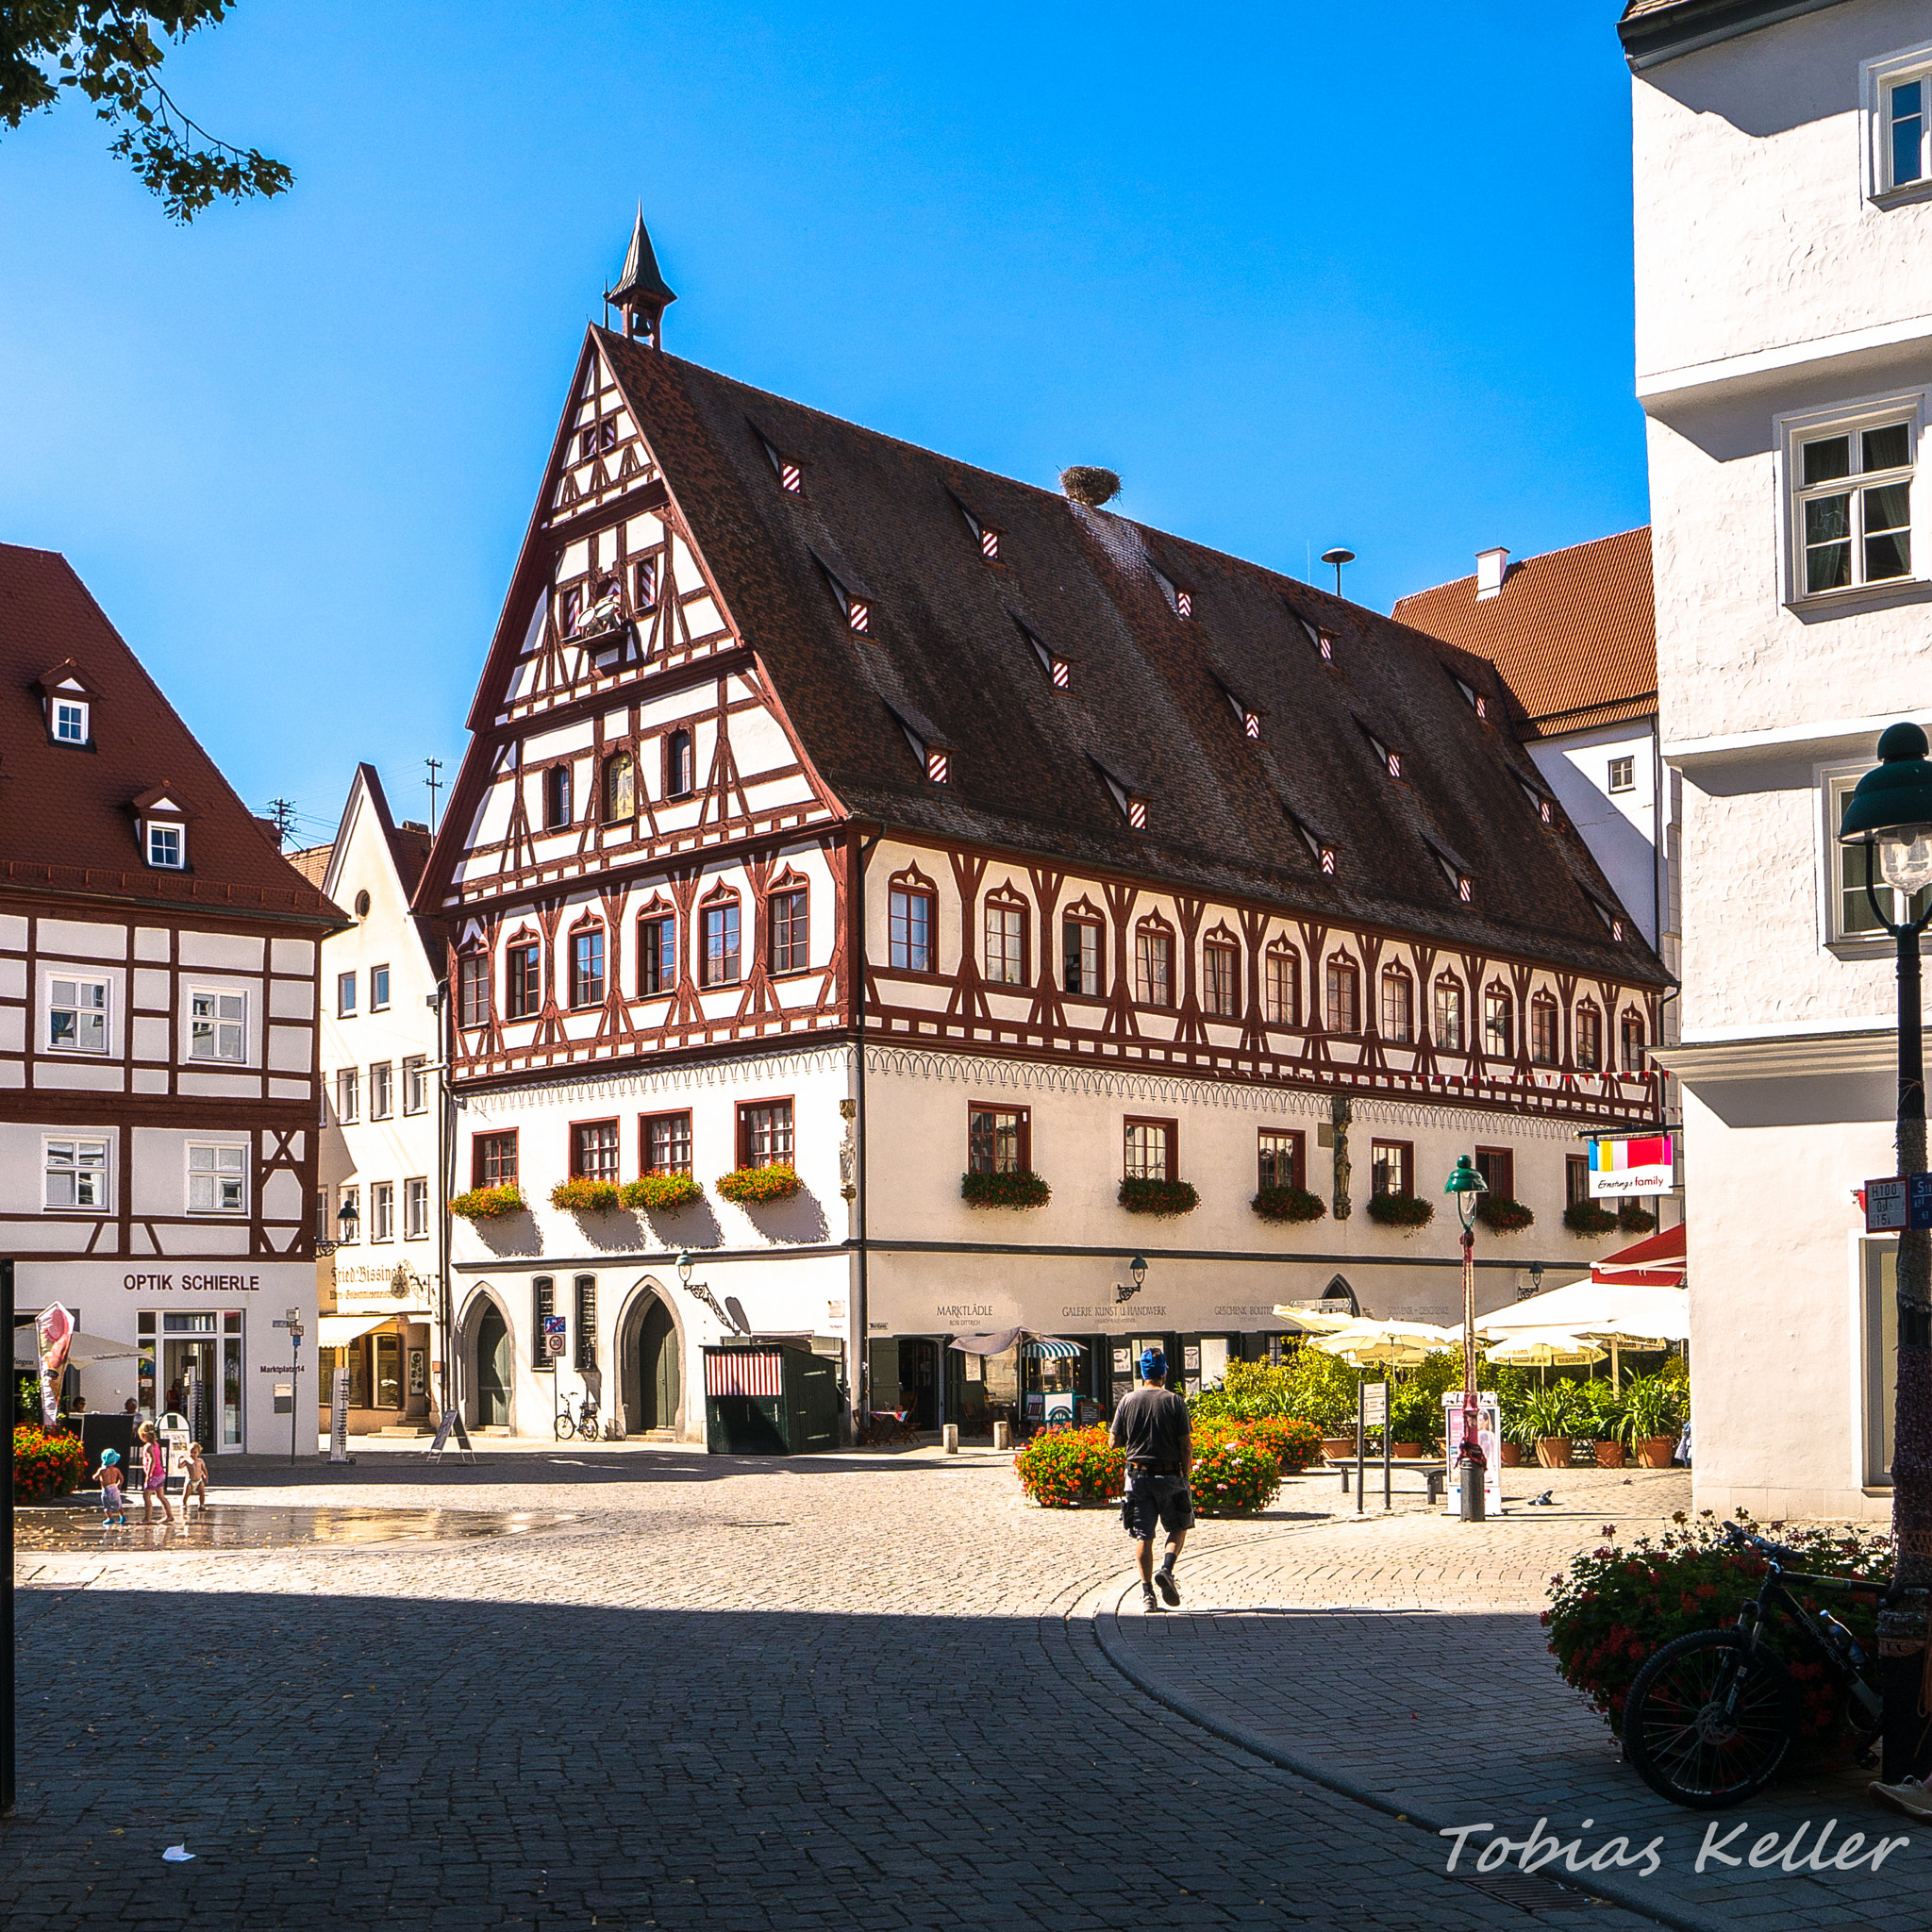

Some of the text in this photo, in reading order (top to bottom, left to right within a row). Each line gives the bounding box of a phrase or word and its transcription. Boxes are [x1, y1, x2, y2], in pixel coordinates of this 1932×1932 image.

[1635, 1175, 1664, 1188] family
[124, 1274, 260, 1291] OPTIK SCHIERLE
[936, 1303, 993, 1319] MARKTLÄDLE
[1061, 1307, 1092, 1317] GALERIE
[1094, 1307, 1118, 1317] KUNST
[1127, 1306, 1167, 1316] HANDWERK
[1794, 1609, 1849, 1672] HAMMER
